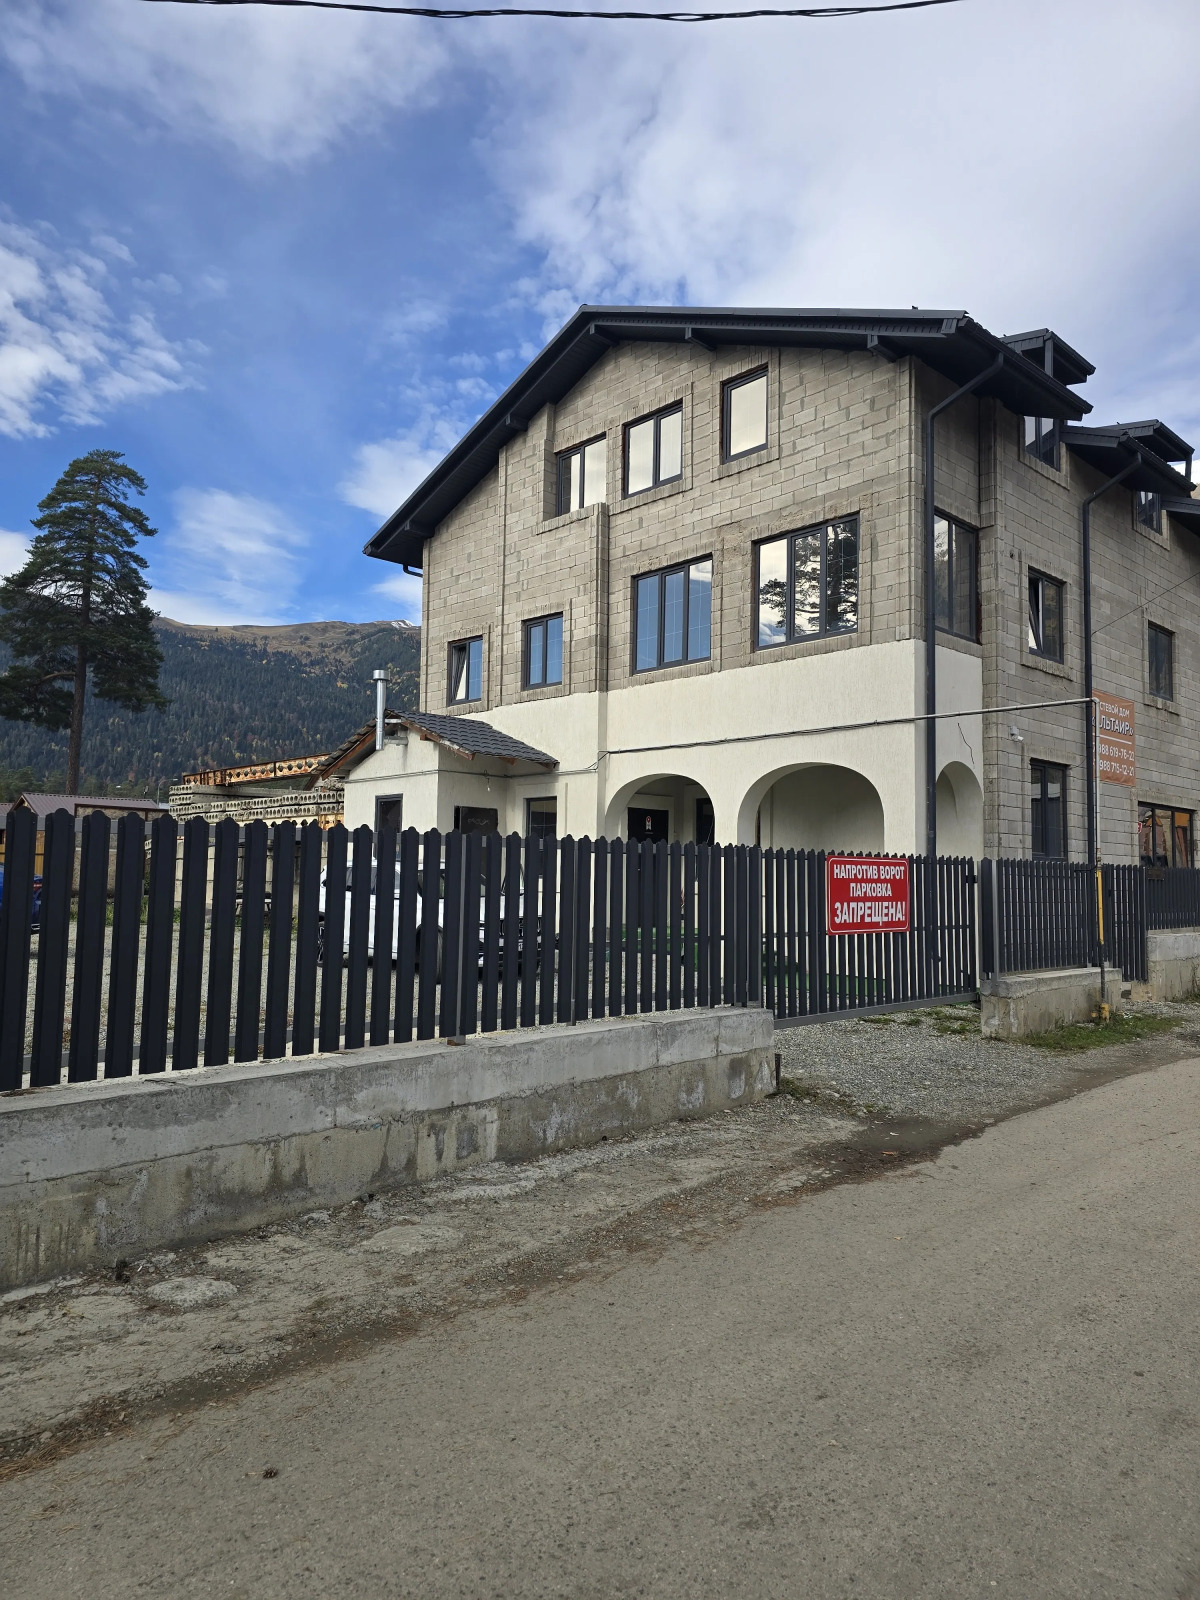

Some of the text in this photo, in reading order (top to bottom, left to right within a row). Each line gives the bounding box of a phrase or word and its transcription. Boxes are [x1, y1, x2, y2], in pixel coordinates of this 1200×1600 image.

[1099, 701, 1130, 718] СТЕВОЙ ДОМ
[1092, 715, 1134, 736] «ЛЬТАИР»
[834, 864, 905, 879] НАПРОТИВ ВОРОТ
[850, 882, 892, 896] ПАРКОВКА
[834, 902, 906, 926] ЗАПРЕЩЕНА!
